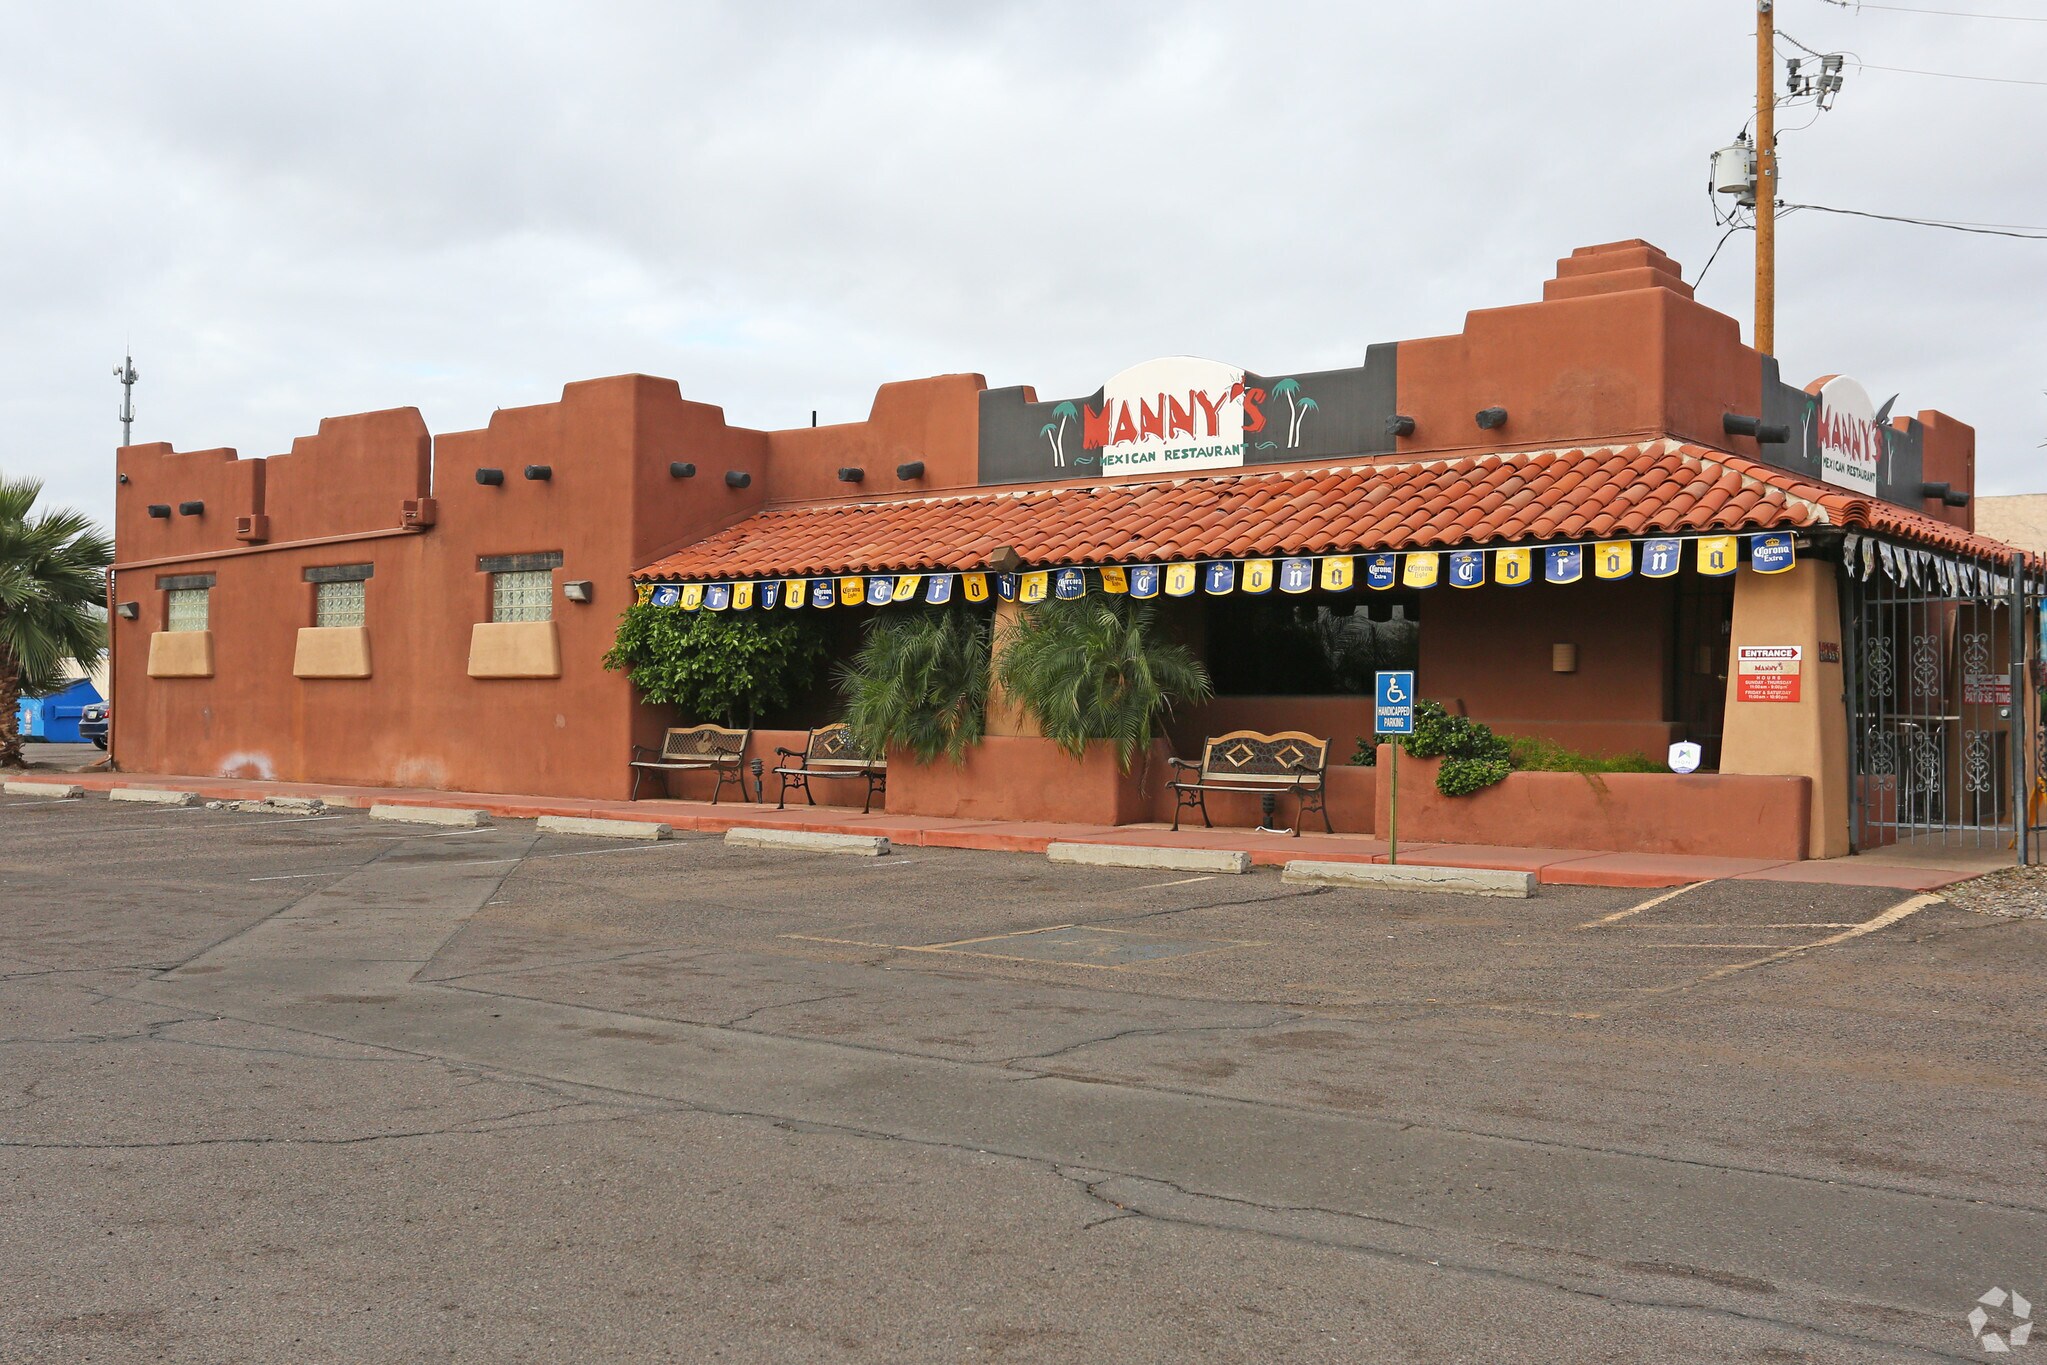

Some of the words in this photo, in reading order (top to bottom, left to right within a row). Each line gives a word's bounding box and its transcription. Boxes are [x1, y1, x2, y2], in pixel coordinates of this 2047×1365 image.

[1082, 384, 1267, 450] MANNY'S
[1817, 404, 1883, 463] MANNY'S
[1100, 452, 1156, 467] MEXICAN
[1165, 443, 1249, 461] RESTAURANT
[1823, 456, 1845, 475] MEXICAN
[1846, 464, 1876, 484] RESTAURANT
[1753, 546, 1790, 558] Corona
[1368, 564, 1392, 574] Corona
[1745, 649, 1793, 657] ENTRANCE
[1965, 692, 1984, 702] PATO
[1984, 692, 2011, 703] SETING
[1378, 706, 1410, 716] HANDICAPPED
[1383, 717, 1404, 727] PARKING
